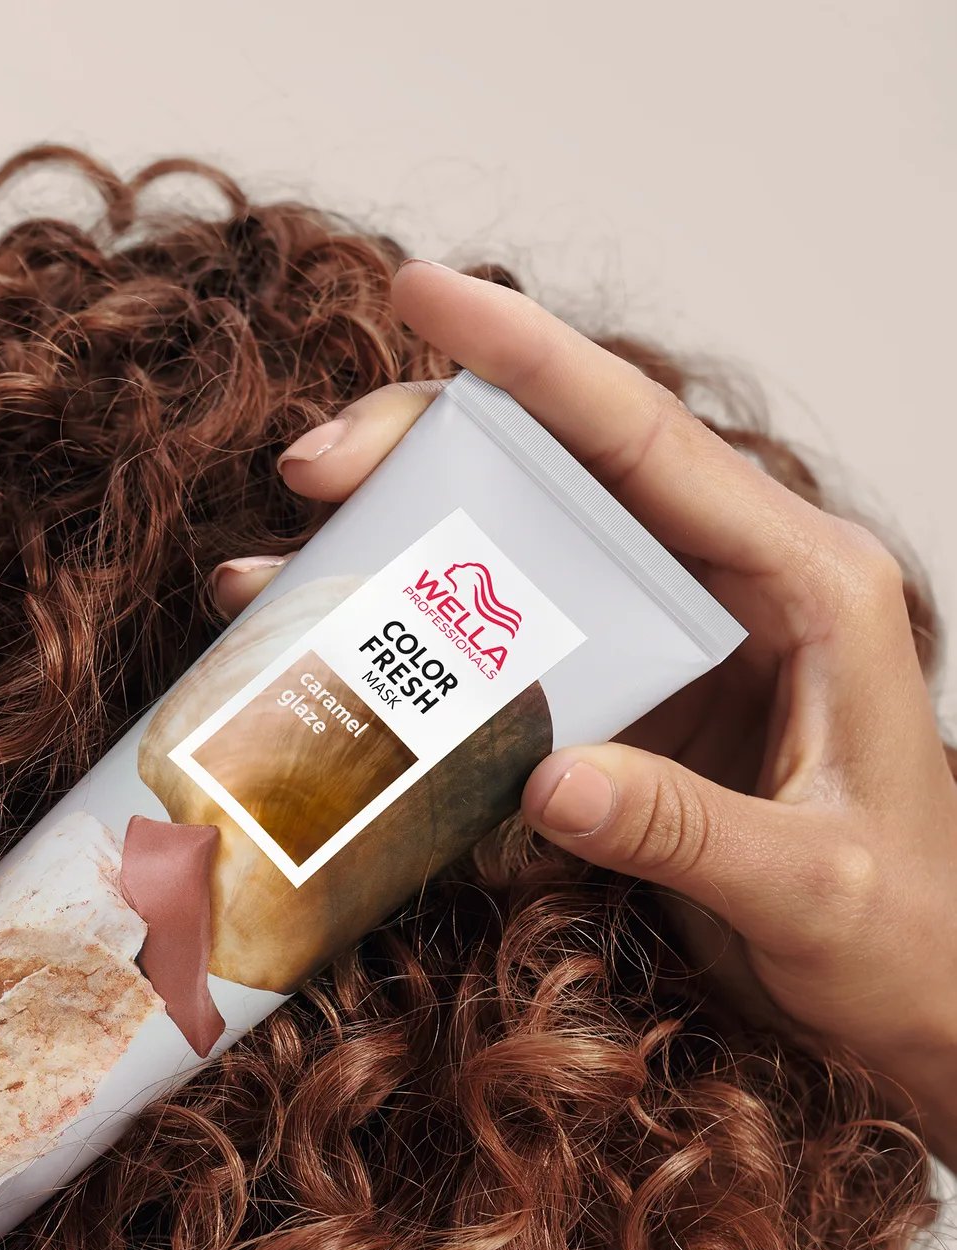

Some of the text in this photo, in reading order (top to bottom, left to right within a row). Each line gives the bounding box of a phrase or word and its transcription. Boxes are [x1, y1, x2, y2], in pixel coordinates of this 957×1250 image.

[402, 586, 498, 680] PROFESSIONALS
[415, 569, 508, 671] WELLA
[359, 635, 440, 715] FRESH
[361, 670, 402, 710] MASK
[383, 621, 458, 697] COLOR
[276, 689, 327, 735] glaze
[300, 673, 370, 739] caramel
